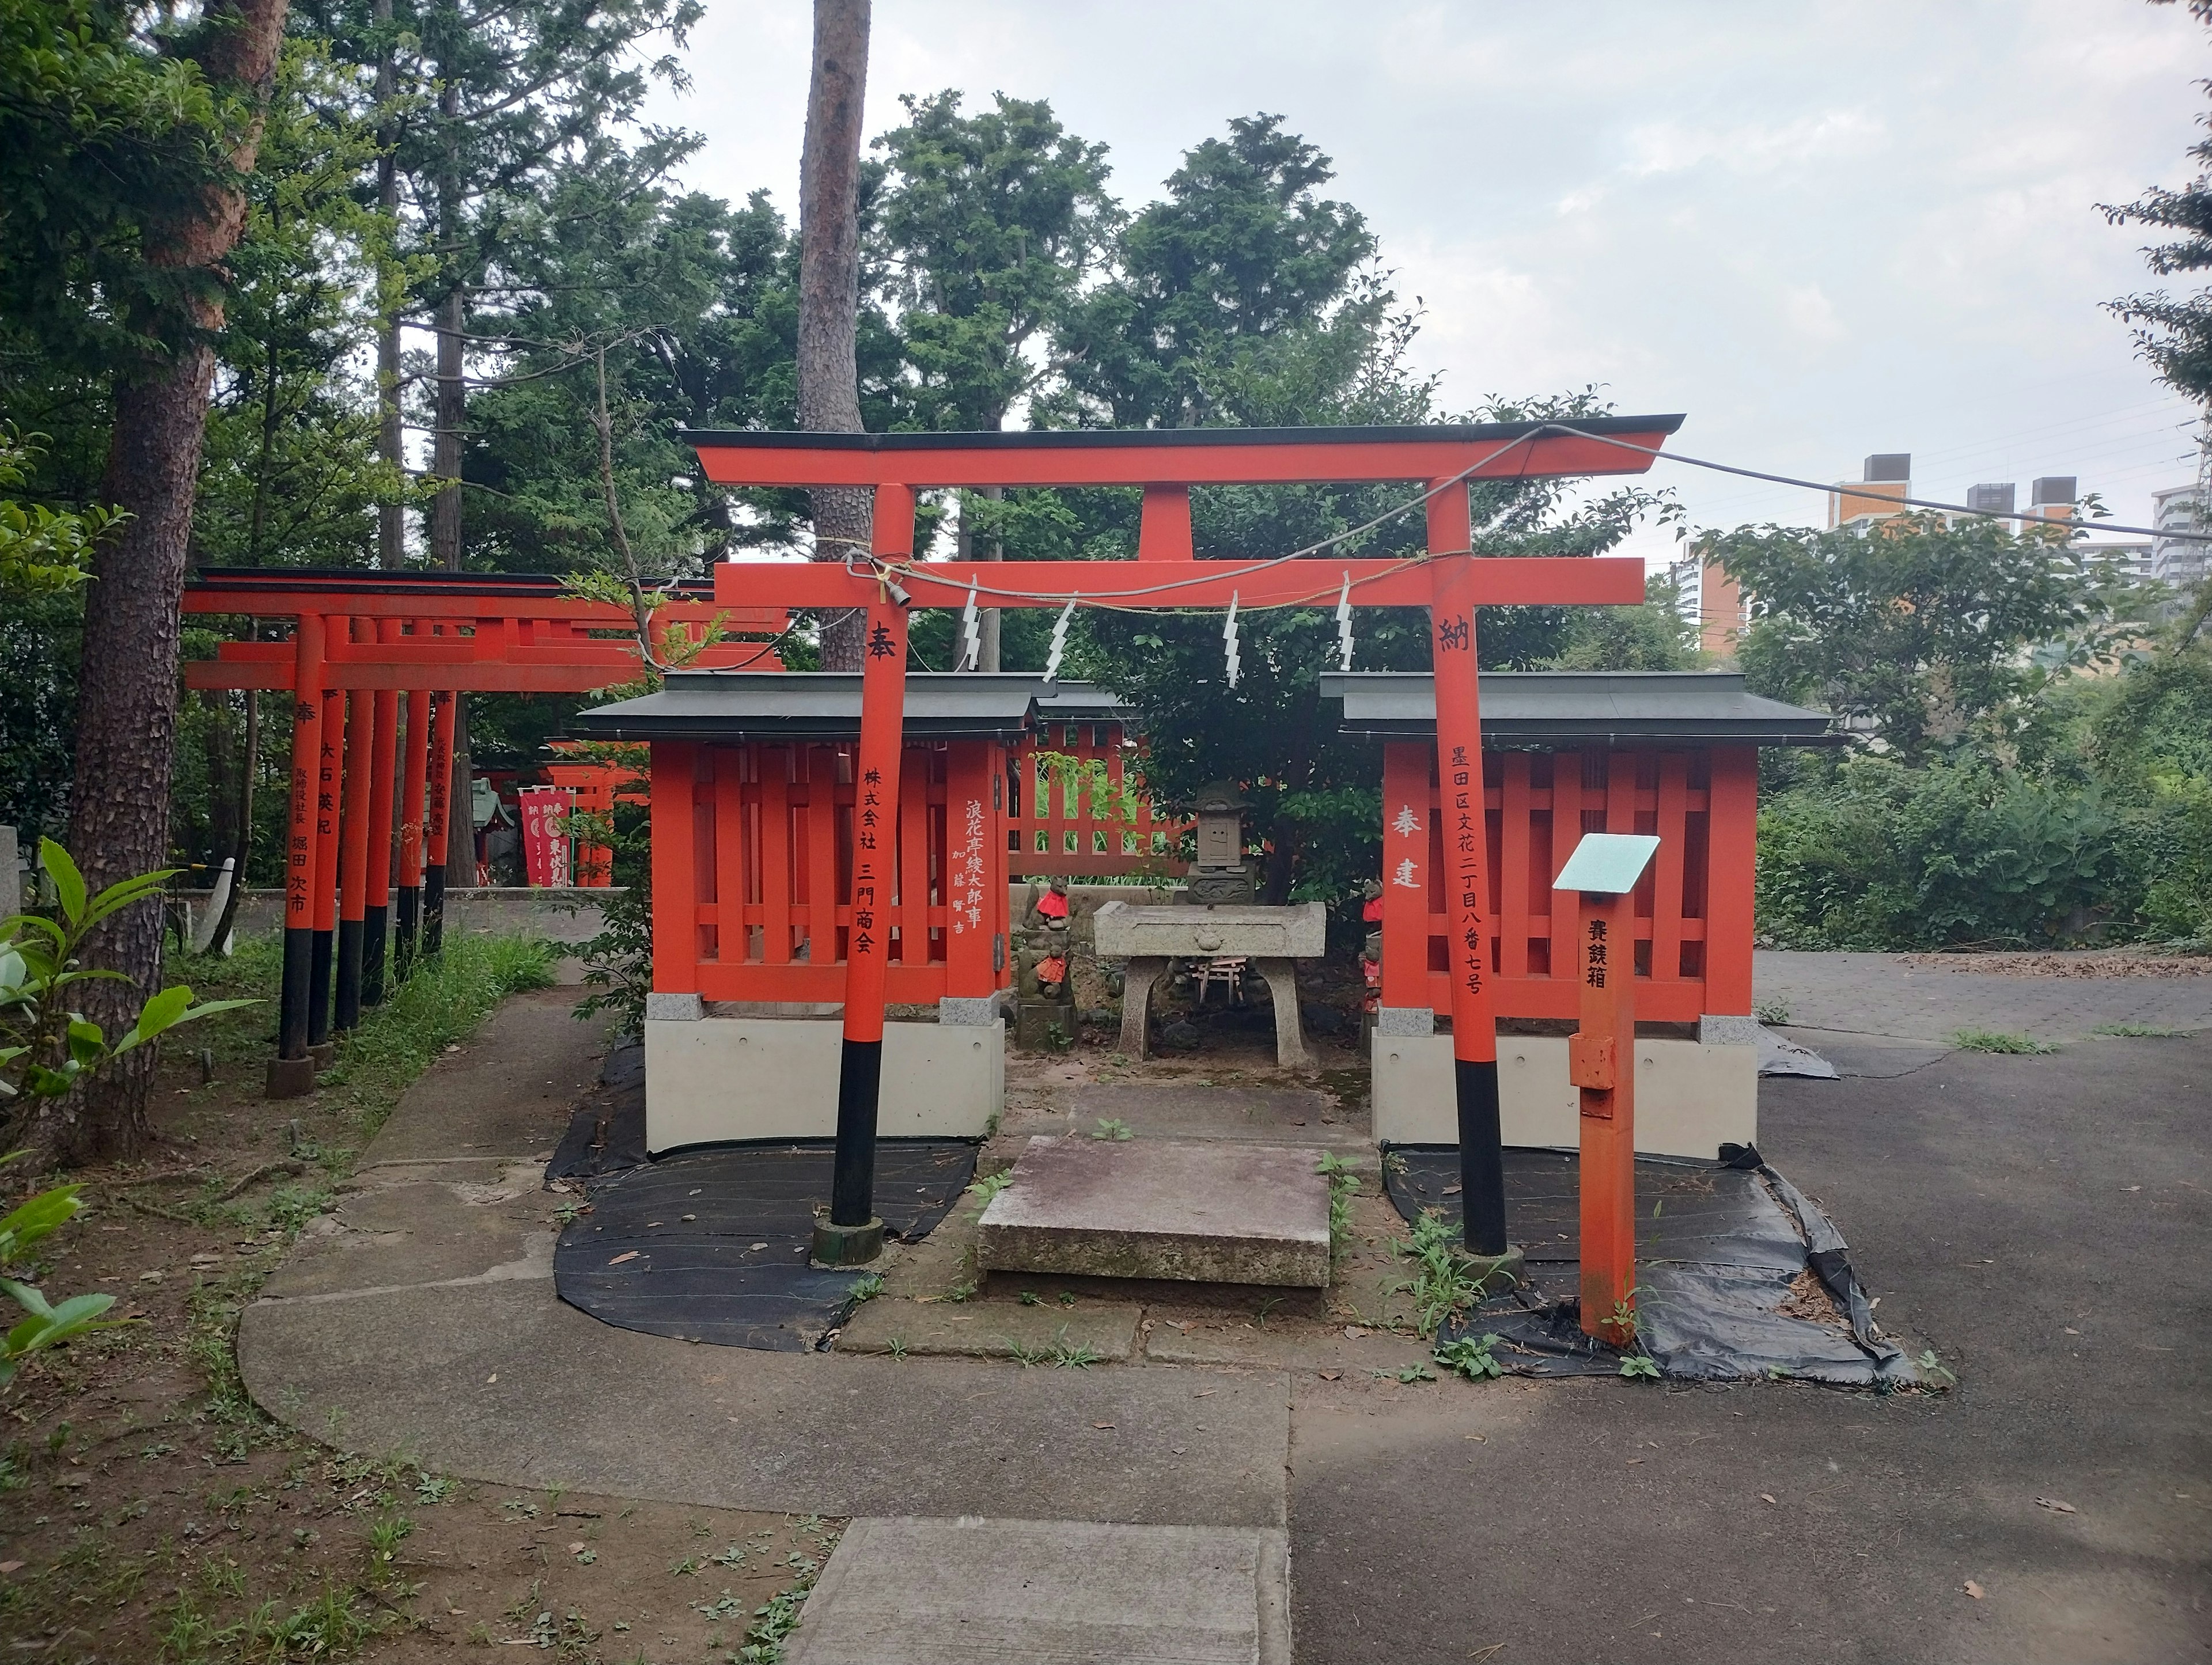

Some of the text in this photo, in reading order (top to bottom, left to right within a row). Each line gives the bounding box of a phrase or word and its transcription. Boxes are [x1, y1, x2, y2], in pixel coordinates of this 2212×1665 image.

[868, 621, 896, 662] 奉
[1438, 614, 1469, 653] 納
[296, 701, 316, 725] 奉
[1450, 746, 1483, 995] 墨田区文花二丁目八番七号
